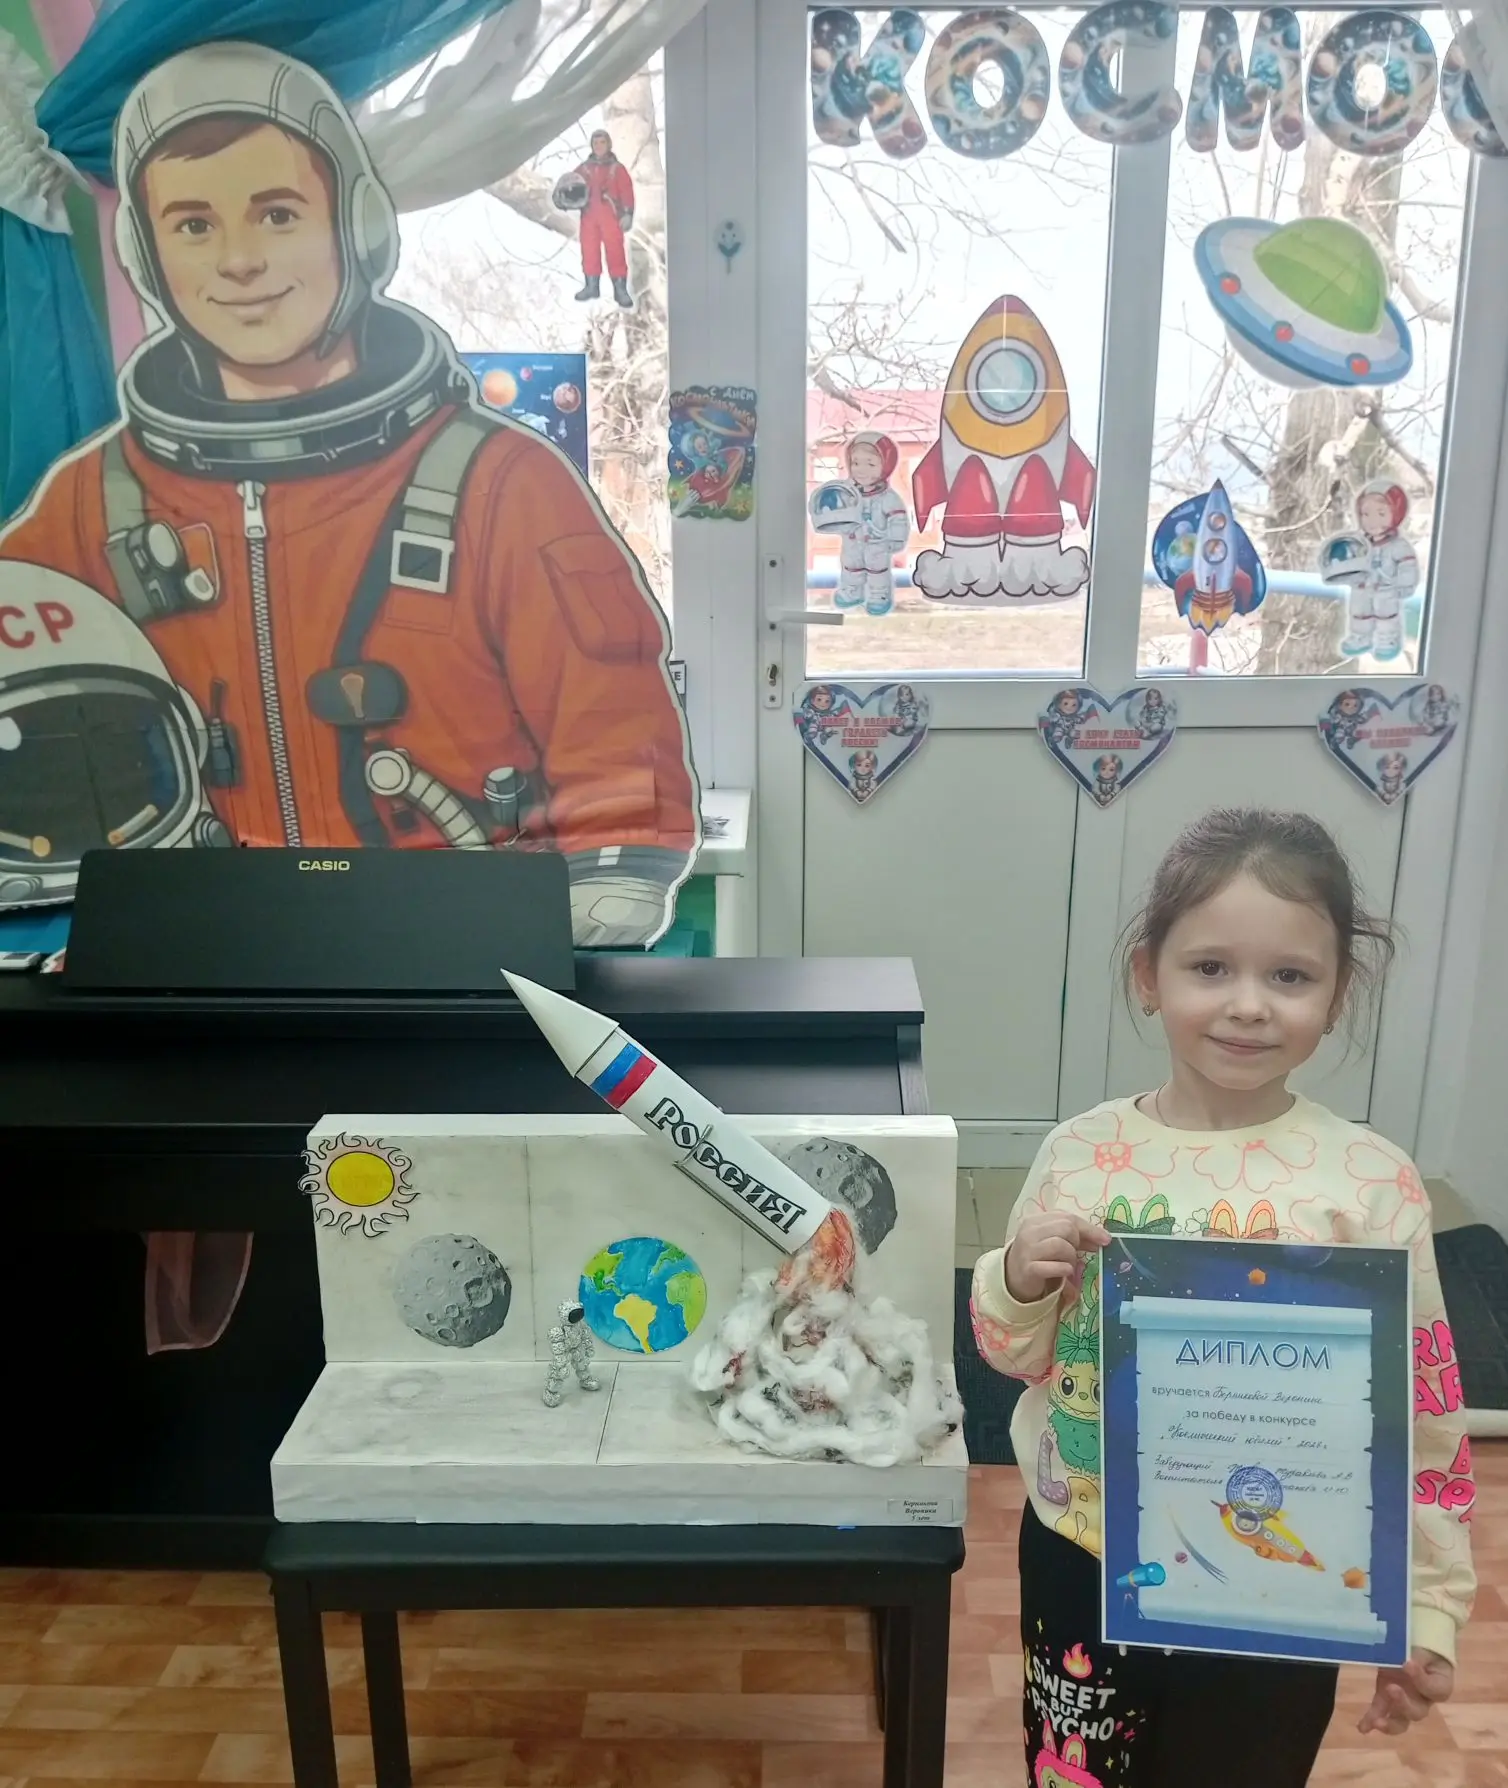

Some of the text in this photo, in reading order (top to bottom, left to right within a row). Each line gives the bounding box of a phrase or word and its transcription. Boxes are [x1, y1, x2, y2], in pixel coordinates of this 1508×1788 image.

[298, 860, 351, 871] CASIO
[644, 1097, 807, 1234] РОССИЯ
[1175, 1338, 1331, 1370] ДИПЛОМ
[1151, 1385, 1210, 1397] вручается
[1185, 1410, 1317, 1427] за победу в конкурсе
[1032, 1655, 1117, 1711] SWEET
[1031, 1685, 1115, 1742] PSYCHO
[1050, 1696, 1084, 1720] BUT
